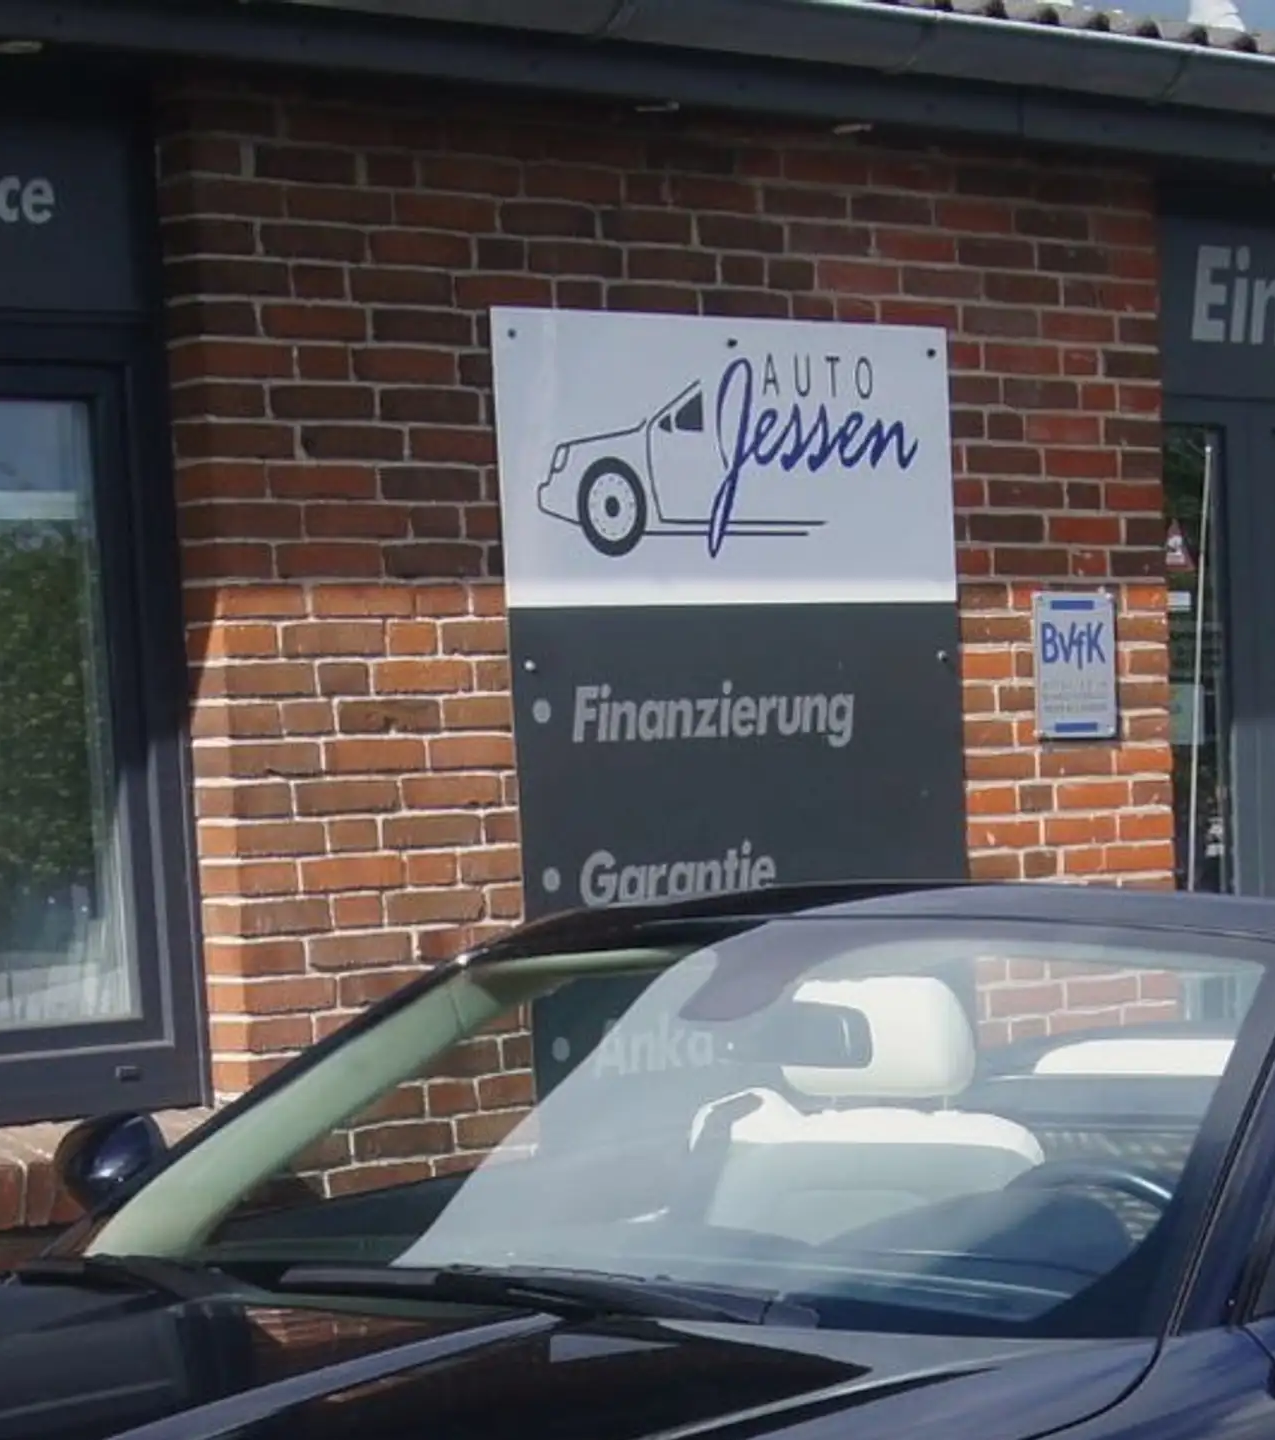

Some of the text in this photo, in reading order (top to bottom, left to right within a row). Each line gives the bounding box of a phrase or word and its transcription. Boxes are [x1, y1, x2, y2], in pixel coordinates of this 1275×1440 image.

[762, 353, 873, 400] AUTO
[707, 357, 919, 559] Jessen
[1041, 620, 1106, 671] BVfK
[572, 679, 855, 748] Finanzierung
[580, 839, 776, 908] Garantie
[594, 1012, 716, 1078] Anka
